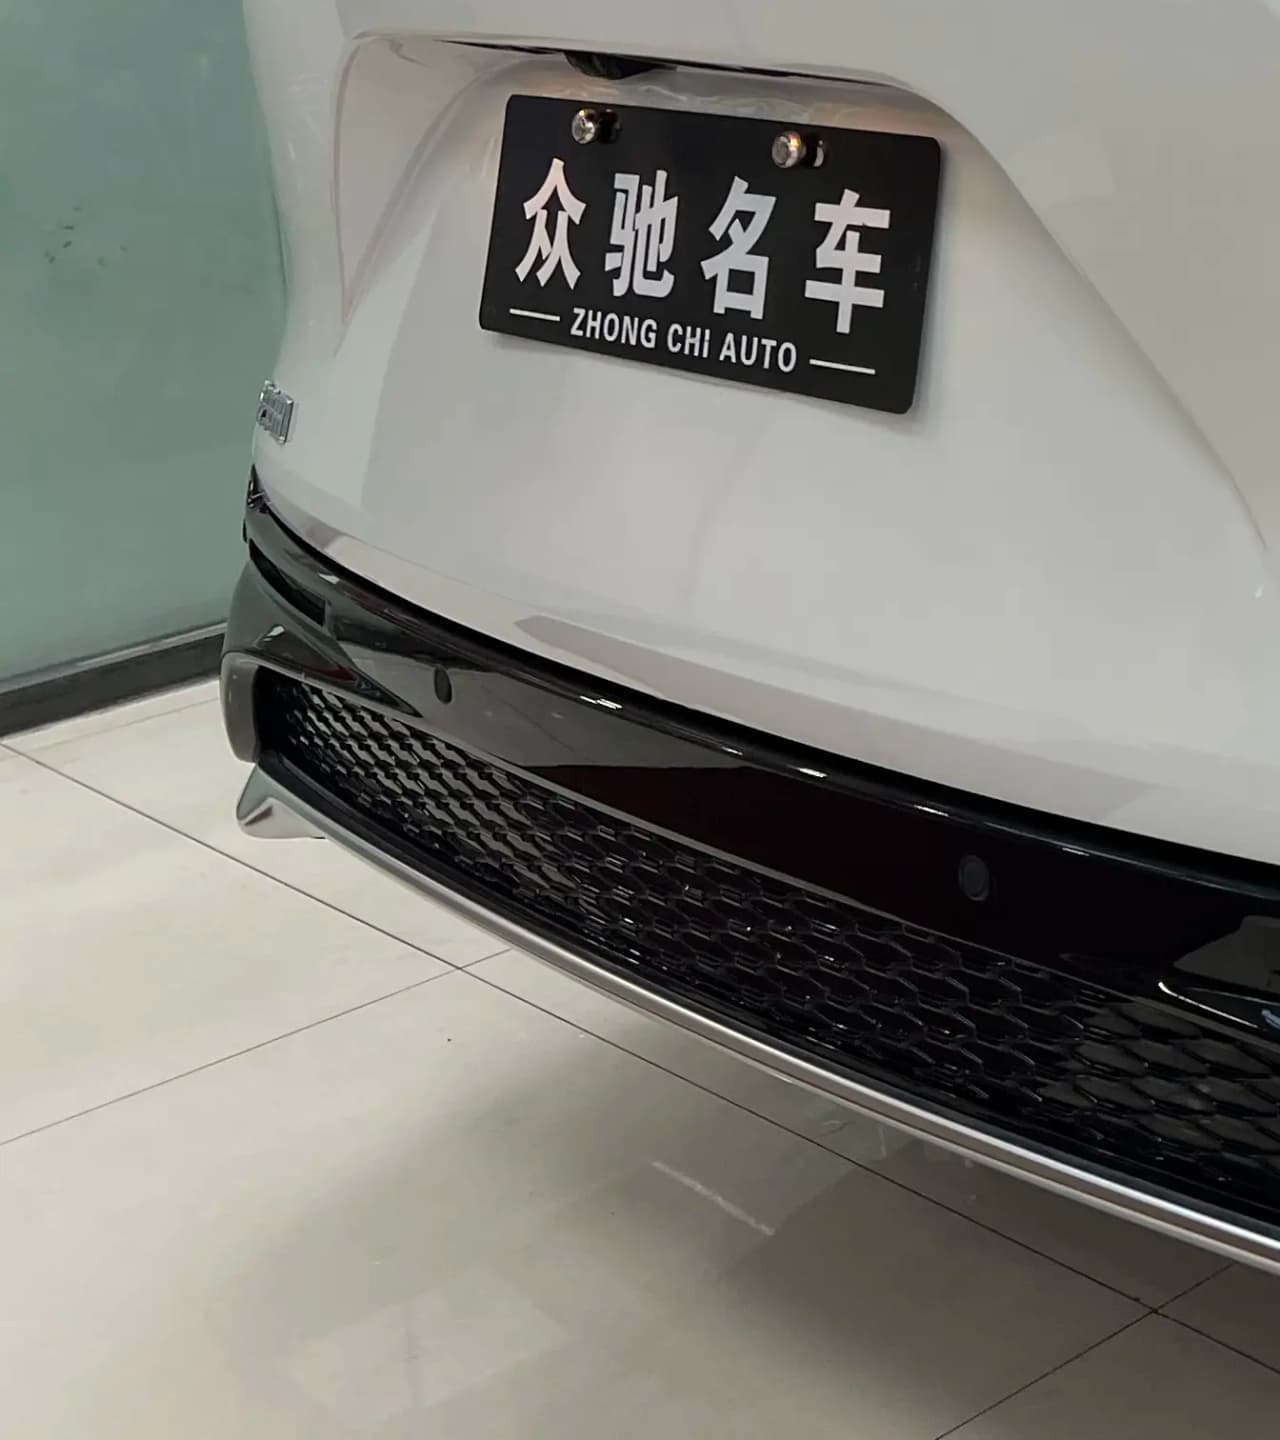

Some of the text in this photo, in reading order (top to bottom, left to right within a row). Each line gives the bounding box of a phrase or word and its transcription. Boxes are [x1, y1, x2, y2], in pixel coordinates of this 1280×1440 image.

[515, 157, 892, 335] 众驰名车
[570, 307, 798, 373] ZHONG CHI AUTO
